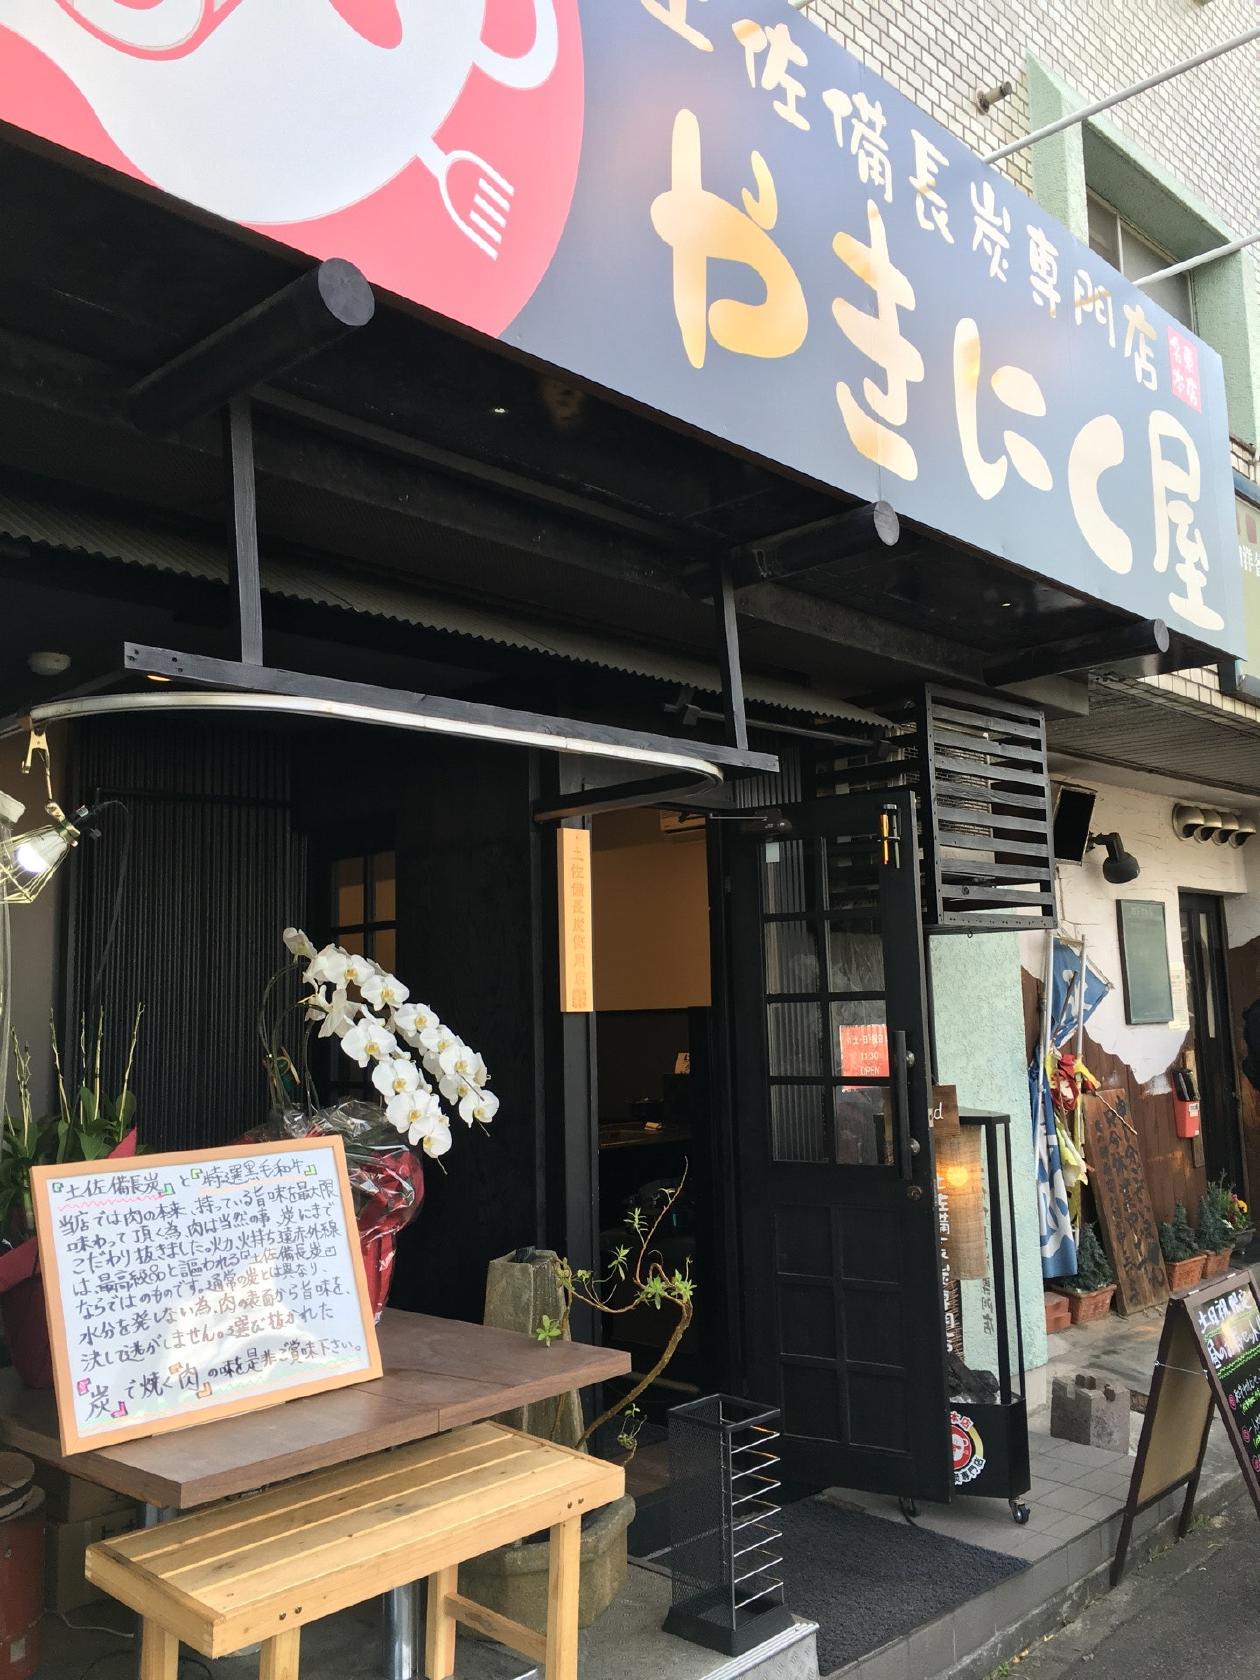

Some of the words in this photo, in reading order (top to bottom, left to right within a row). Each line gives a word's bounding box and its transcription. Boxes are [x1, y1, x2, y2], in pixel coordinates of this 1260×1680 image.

[650, 108, 1225, 631] やきにく屋
[860, 1065, 880, 1075] OPEN
